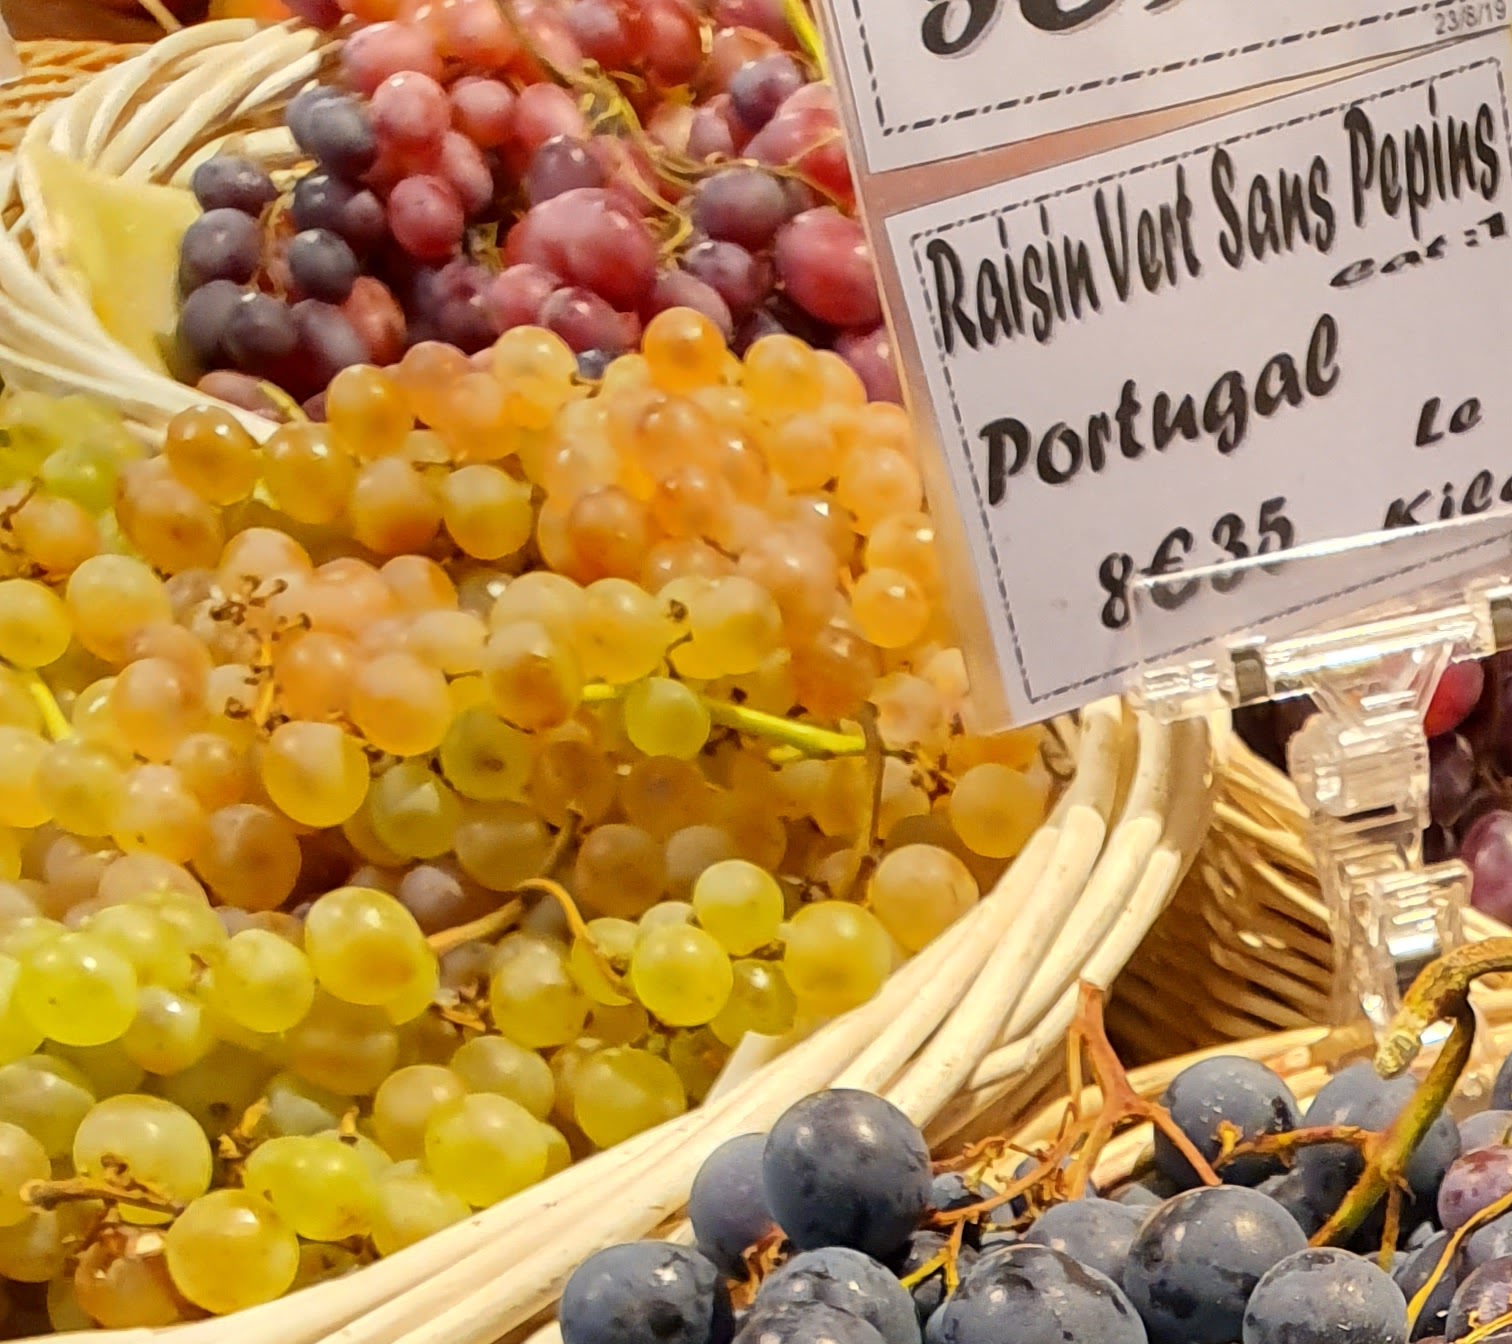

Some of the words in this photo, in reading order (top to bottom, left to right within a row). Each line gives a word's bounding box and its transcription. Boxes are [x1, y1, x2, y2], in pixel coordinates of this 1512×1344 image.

[1434, 3, 1507, 35] 23/8/19
[926, 202, 1102, 354] Raisin
[1094, 161, 1202, 303] Vert
[1211, 147, 1336, 269] Sans
[1343, 83, 1499, 241] Pepins
[978, 312, 1340, 506] Portugal
[1414, 396, 1482, 447] Le
[1098, 496, 1296, 629] 8€35
